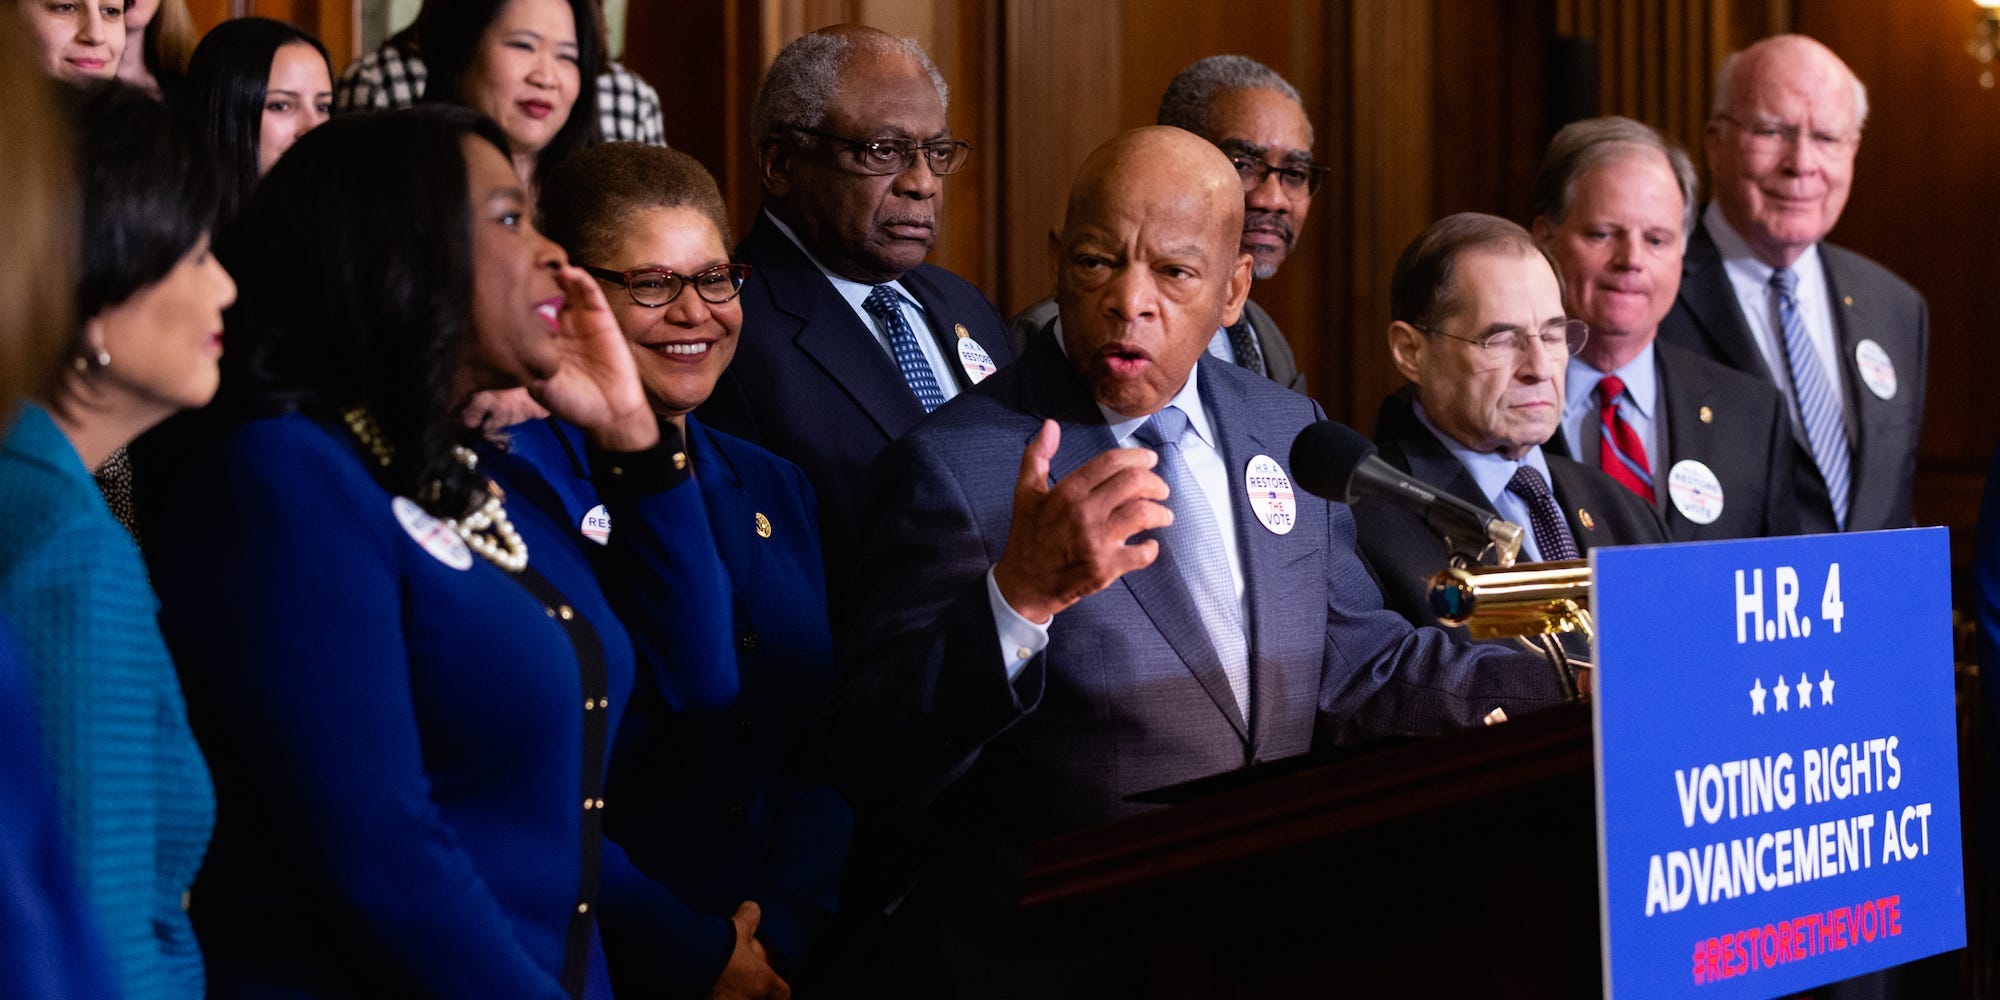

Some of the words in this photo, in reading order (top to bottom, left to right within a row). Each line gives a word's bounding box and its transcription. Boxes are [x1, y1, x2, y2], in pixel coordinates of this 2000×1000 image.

[1249, 477, 1289, 489] RESTORE
[1255, 464, 1271, 474] H.R.
[1265, 513, 1292, 526] VOTE
[1268, 501, 1284, 512] THE
[1735, 566, 1811, 644] H.R.
[1821, 562, 1845, 634] 4
[1674, 752, 1796, 828] VOTING
[1803, 735, 1901, 805] RIGHTS
[1645, 813, 1875, 918] ADVANCEMENT
[1882, 802, 1932, 865] ACT
[1692, 894, 1903, 985] #RESTORETHEVOTE
